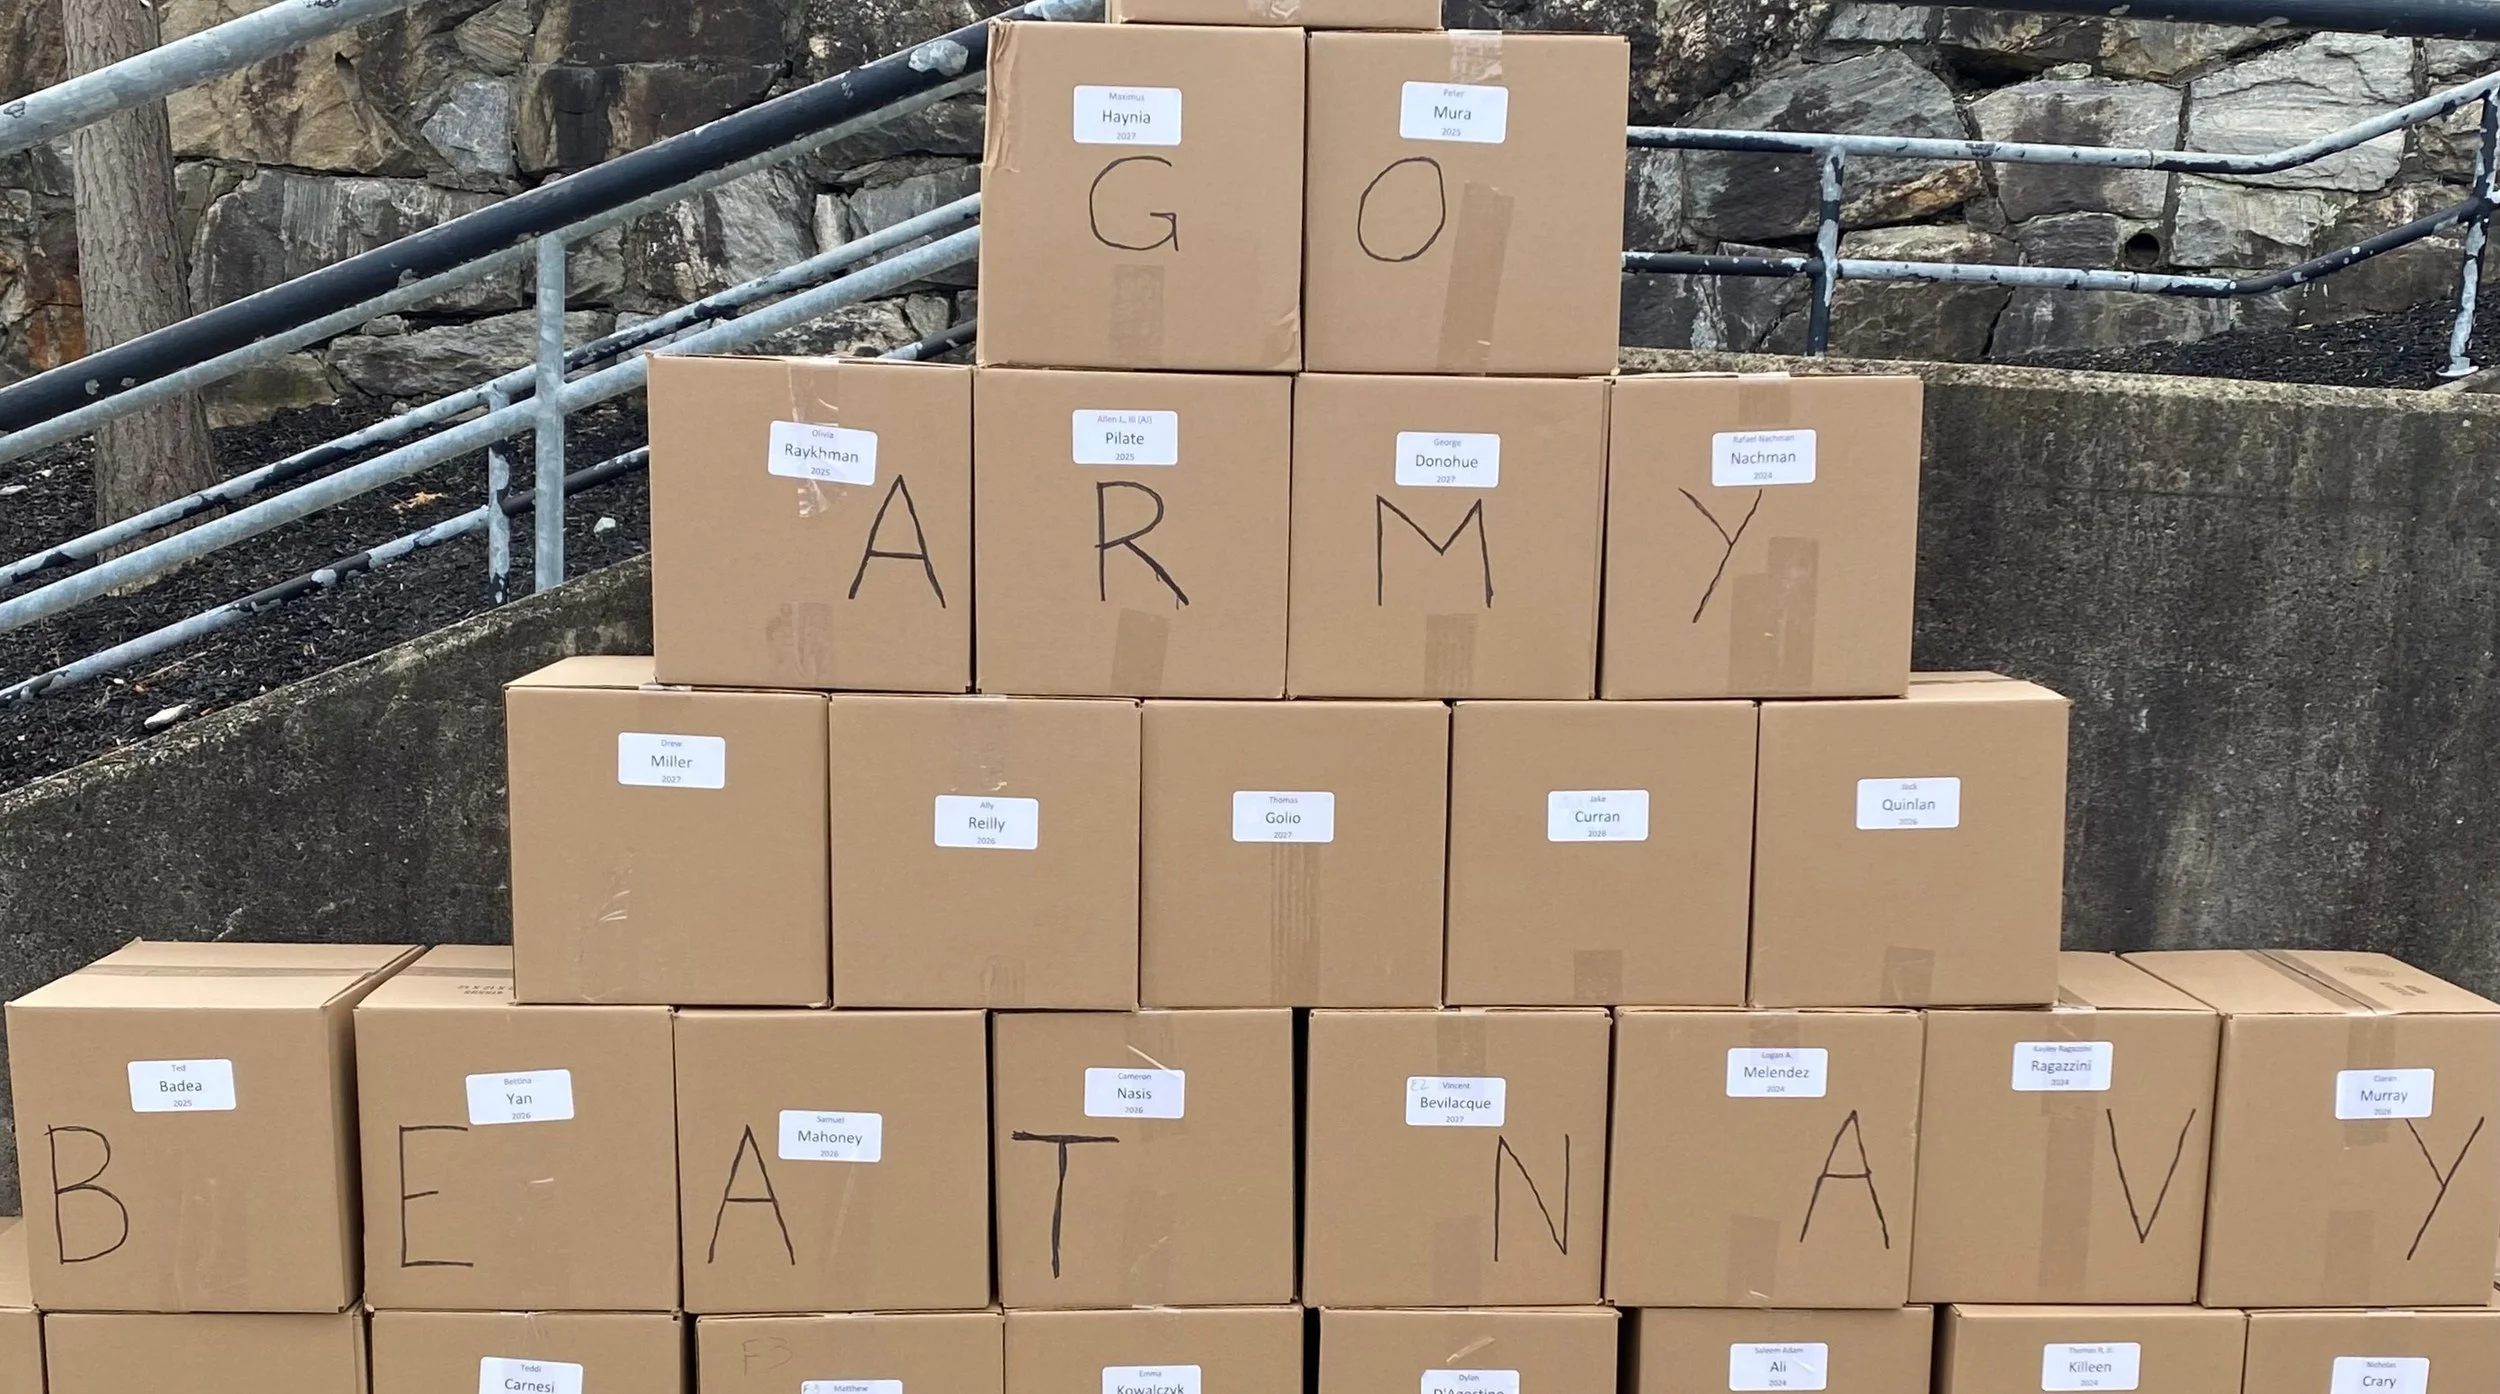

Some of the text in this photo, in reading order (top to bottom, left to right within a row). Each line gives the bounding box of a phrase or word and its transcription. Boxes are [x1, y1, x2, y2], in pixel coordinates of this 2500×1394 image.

[1109, 93, 1144, 102] Maximus
[1444, 89, 1465, 97] Peter
[1102, 110, 1151, 125] Haynia
[1434, 106, 1471, 120] Mura
[1090, 156, 1446, 262] G O
[812, 430, 834, 439] Olivia
[1106, 432, 1144, 445] Pilate
[1759, 434, 1794, 442] Nachman
[1434, 439, 1461, 447] George
[785, 443, 858, 463] Raykhman
[1731, 451, 1796, 464] Nachman
[1416, 454, 1478, 468] Donohue
[811, 467, 830, 476] 2025
[848, 475, 1763, 623] A R M Y
[651, 755, 693, 768] Miller
[980, 802, 994, 810] Ally
[1269, 796, 1298, 804] Thomas
[1882, 798, 1935, 812] Quinlan
[1266, 812, 1301, 824] Golio
[1575, 811, 1620, 822] Curran
[969, 817, 1006, 832] Reilly
[1762, 1052, 1783, 1060] Logan
[1744, 1067, 1809, 1078] Melendez
[2032, 1060, 2091, 1074] Ragazzini
[160, 1080, 202, 1092] Badea
[504, 1078, 532, 1086] Bettina
[506, 1093, 532, 1105] Yan
[1117, 1088, 1152, 1100] Nasis
[2361, 1090, 2408, 1103] Murray
[1125, 1106, 1143, 1114] 2026
[1420, 1097, 1491, 1111] Bevilacque
[816, 1116, 844, 1124] Samuel
[798, 1130, 862, 1146] Mahoney
[45, 1108, 2485, 1279] B E A T N A V Y
[521, 1365, 541, 1373] Teddi
[1770, 1361, 1786, 1373] Ali
[2069, 1362, 2112, 1373] Killeen
[1139, 1370, 1162, 1378] Emma
[1459, 1374, 1479, 1382] Dylan
[505, 1378, 555, 1394] Carnesi
[2363, 1375, 2396, 1389] Crary
[834, 1385, 868, 1393] Matthew
[1117, 1384, 1184, 1394] Kowalczyk
